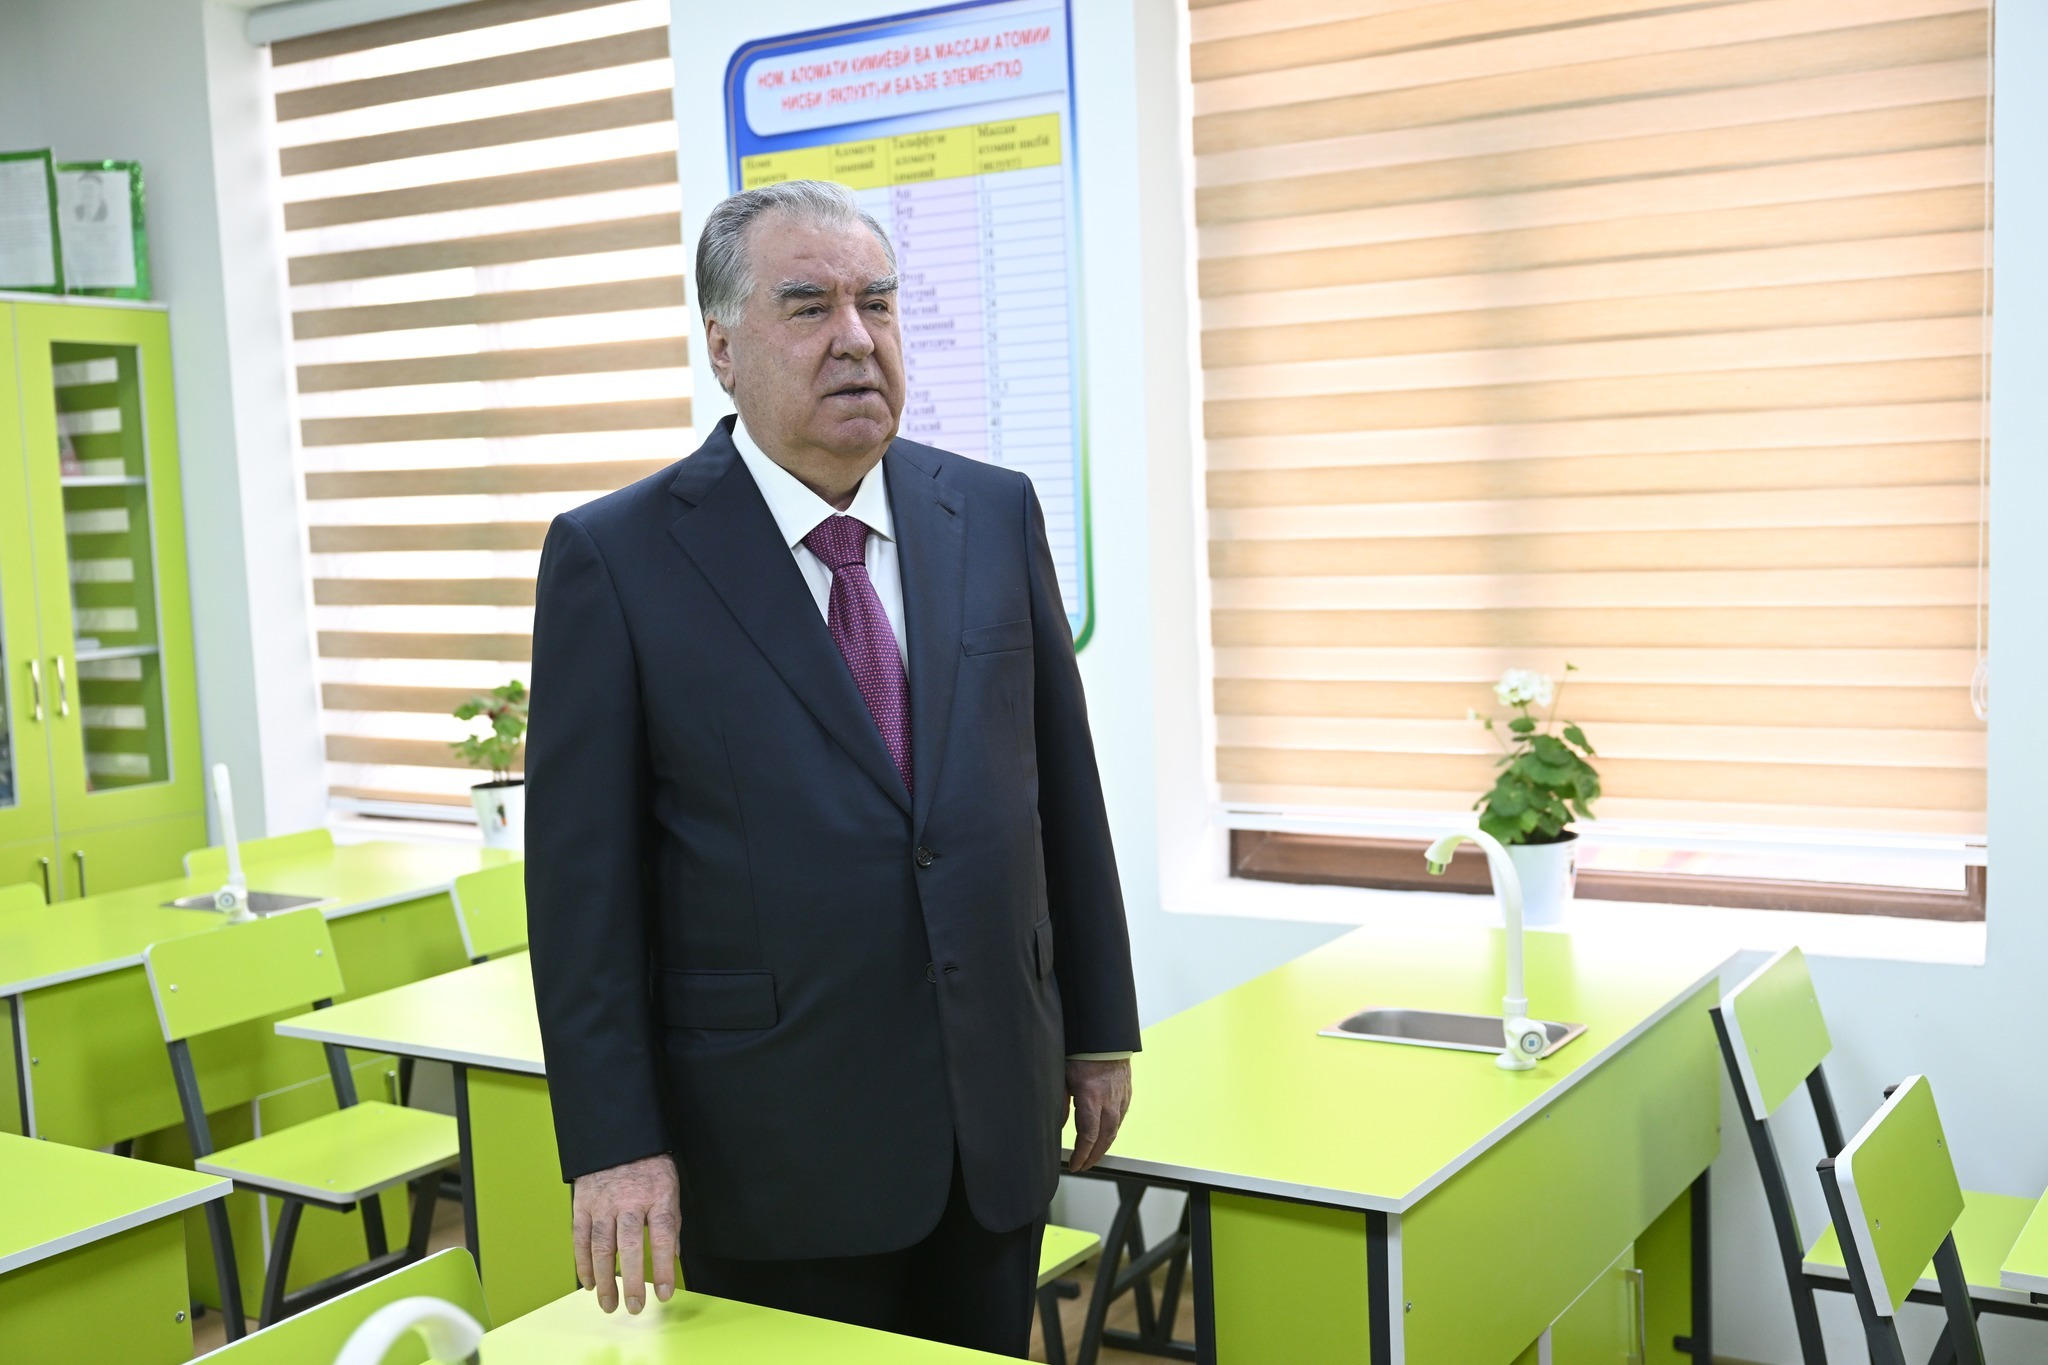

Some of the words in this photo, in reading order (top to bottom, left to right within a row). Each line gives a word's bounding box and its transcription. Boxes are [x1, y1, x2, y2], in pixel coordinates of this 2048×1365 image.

[791, 60, 848, 83] АЛОМАТИ
[914, 46, 931, 64] ВА
[934, 36, 990, 59] МАССАИ
[994, 25, 1051, 49] АТОМИИ
[894, 72, 938, 95] БАЪЗЕ
